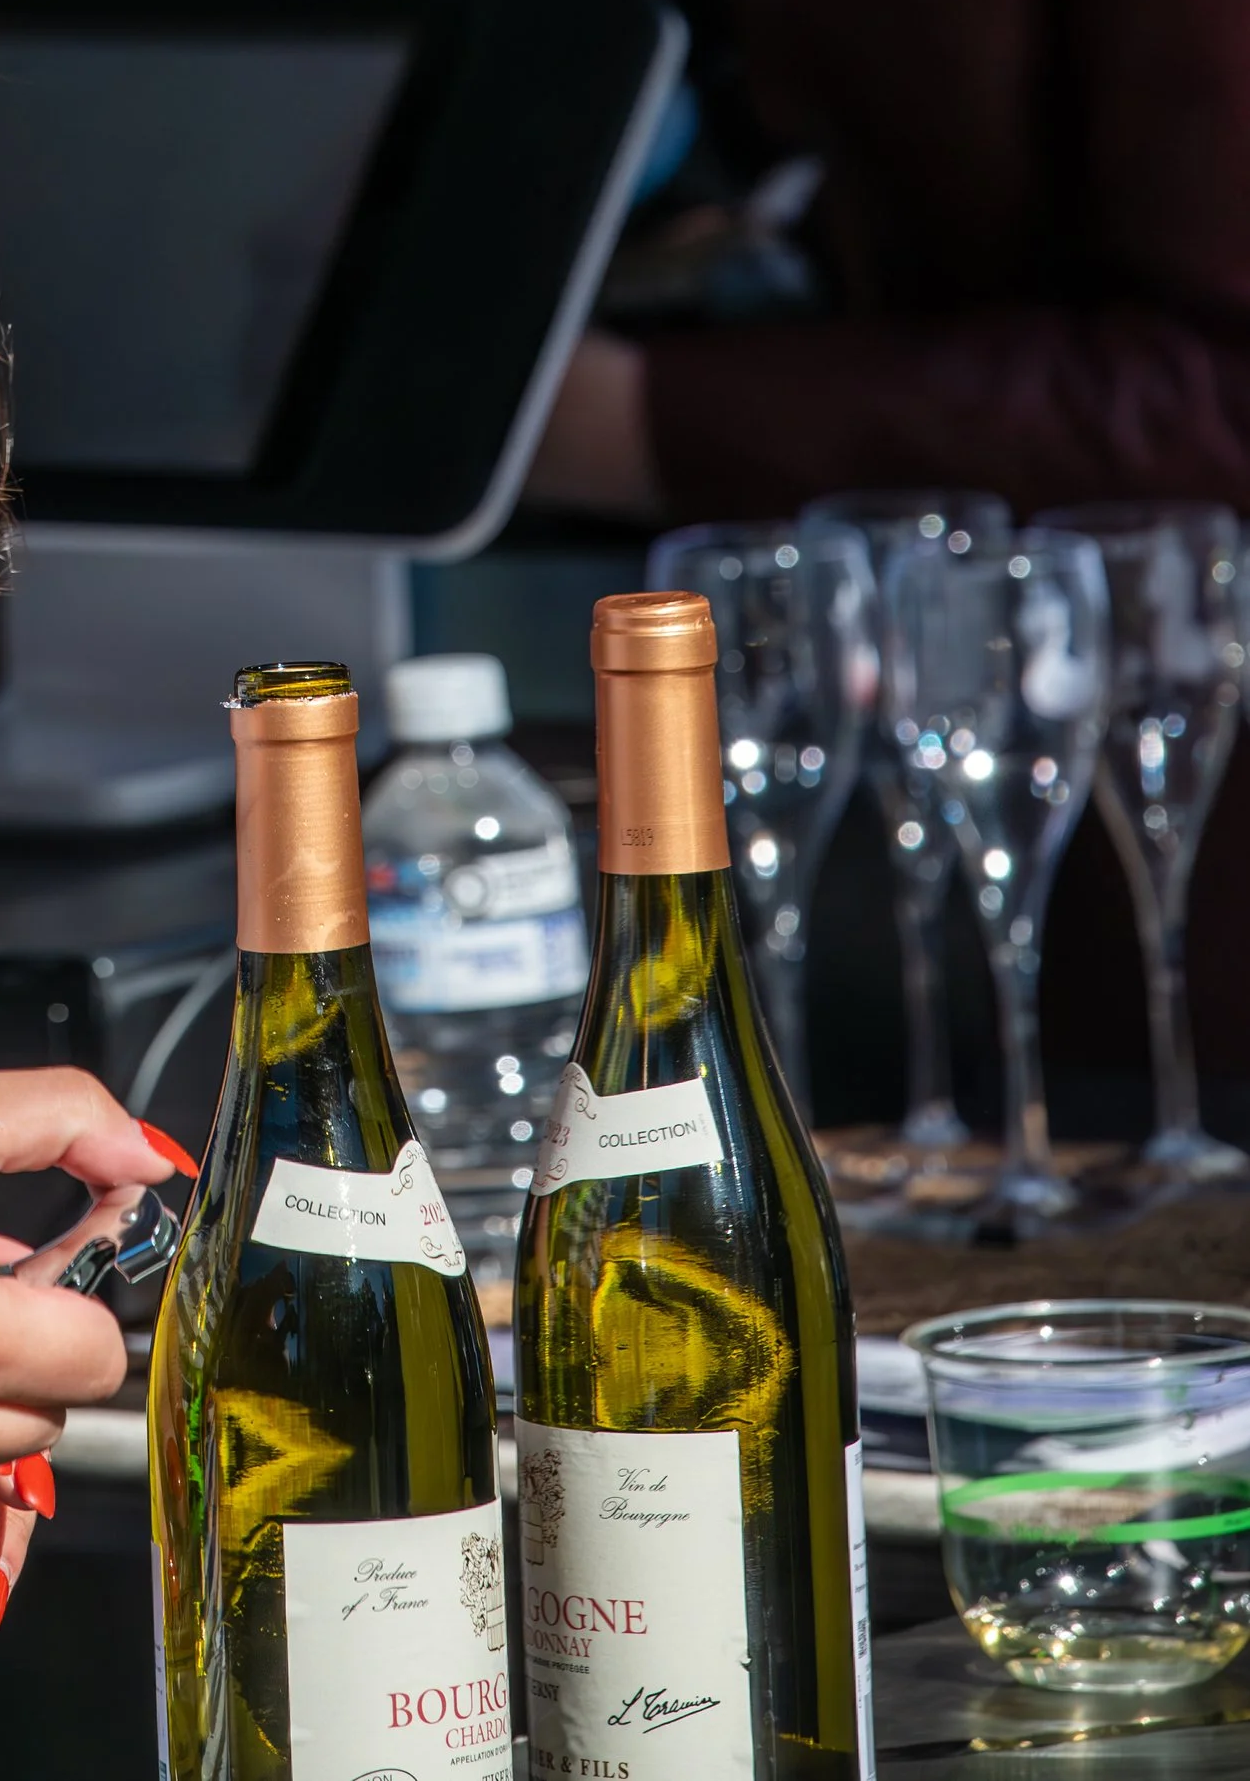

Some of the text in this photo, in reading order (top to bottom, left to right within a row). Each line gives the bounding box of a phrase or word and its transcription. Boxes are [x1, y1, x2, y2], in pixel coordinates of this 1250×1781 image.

[598, 1120, 698, 1149] COLLECTION
[285, 1195, 386, 1226] COLLECTION
[617, 1468, 668, 1492] Vin de
[599, 1496, 690, 1528] Bourgogne
[354, 1558, 418, 1583] Produce
[341, 1586, 430, 1621] of France
[387, 1672, 508, 1729] BOURG
[450, 1748, 495, 1766] APPELLATION
[561, 1756, 572, 1773] &
[581, 1759, 630, 1780] FILS
